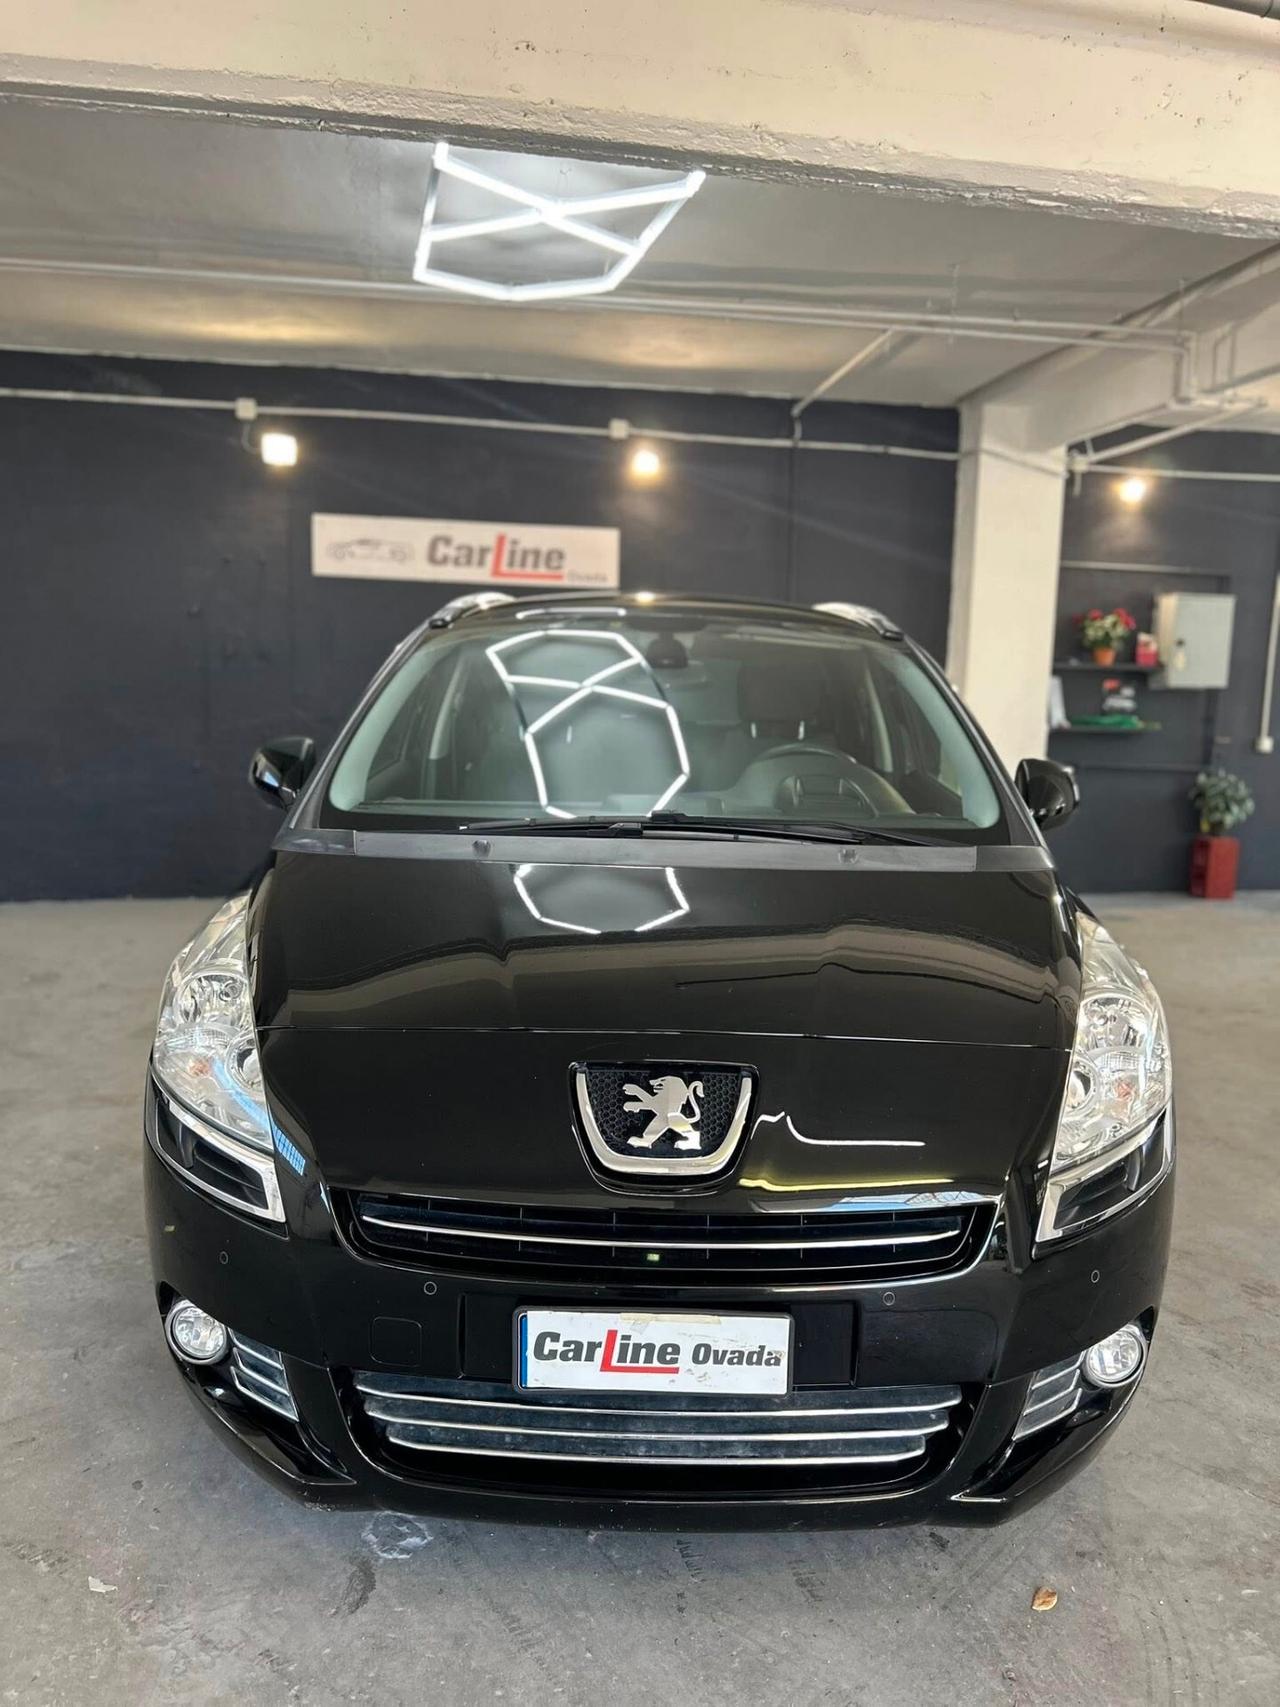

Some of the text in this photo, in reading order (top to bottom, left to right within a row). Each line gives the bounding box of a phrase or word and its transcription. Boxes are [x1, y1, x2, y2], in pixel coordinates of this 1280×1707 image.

[427, 532, 566, 580] CarLine
[533, 1329, 782, 1374] CarLine Ovada
